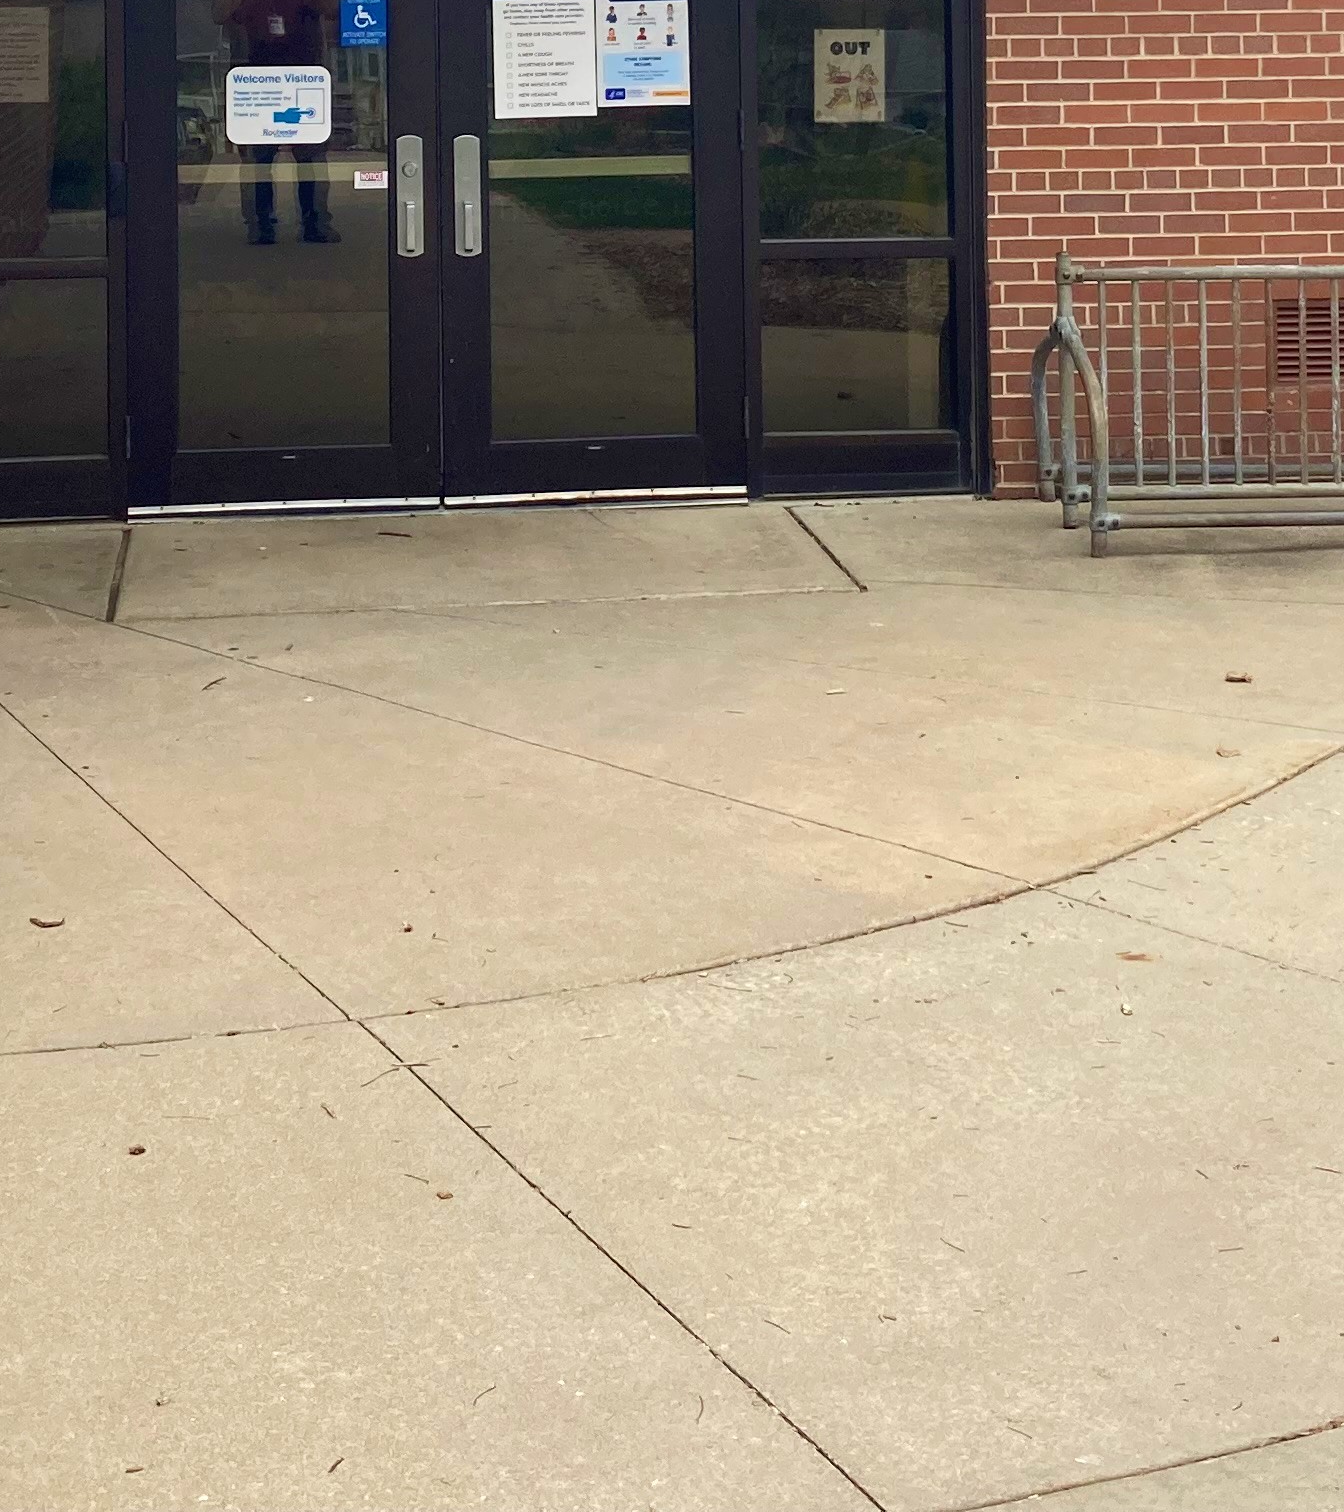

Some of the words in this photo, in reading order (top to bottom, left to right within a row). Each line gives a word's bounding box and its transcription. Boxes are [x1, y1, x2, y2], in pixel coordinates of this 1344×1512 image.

[830, 42, 870, 55] OUT
[233, 74, 281, 83] Welcome
[284, 74, 325, 83] Visitors
